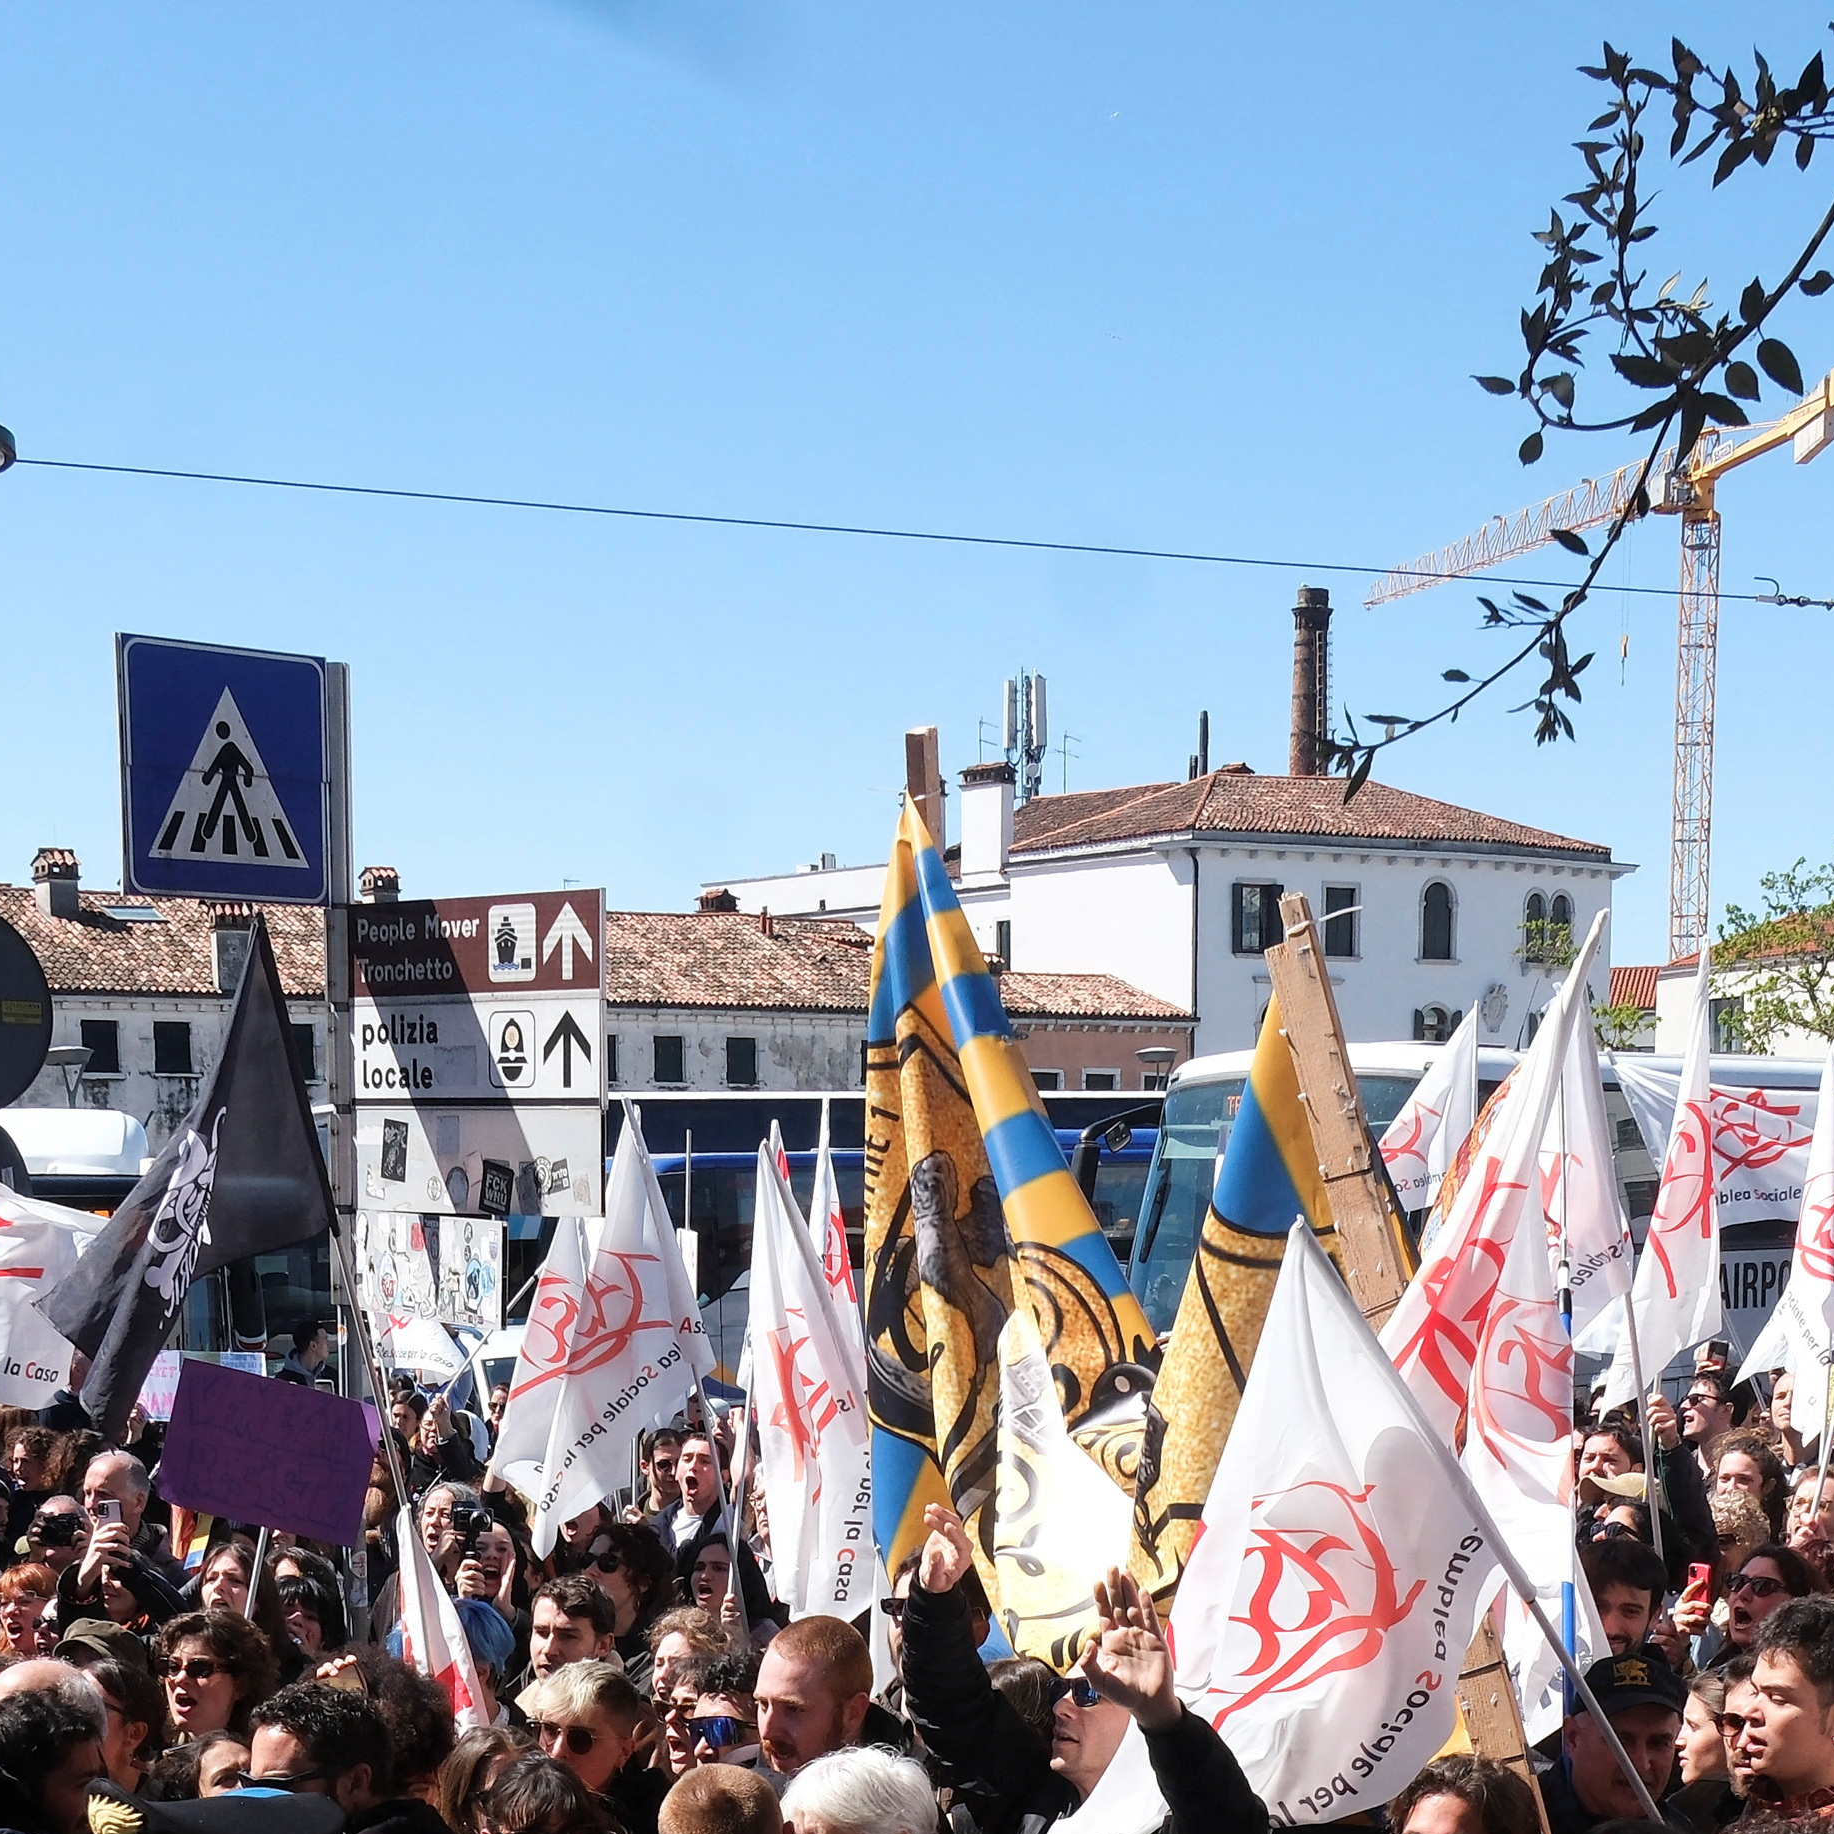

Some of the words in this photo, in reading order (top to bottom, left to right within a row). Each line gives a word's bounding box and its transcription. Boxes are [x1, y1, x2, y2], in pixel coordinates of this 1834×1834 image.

[357, 915, 416, 945] People
[424, 914, 480, 939] Mover
[358, 956, 453, 983] Tronchetto
[362, 1013, 439, 1052] polizia
[362, 1058, 433, 1089] locale
[486, 1173, 508, 1193] FCK
[1753, 1186, 1801, 1203] Sociale
[3, 1356, 22, 1377] la
[24, 1361, 59, 1384] Casa
